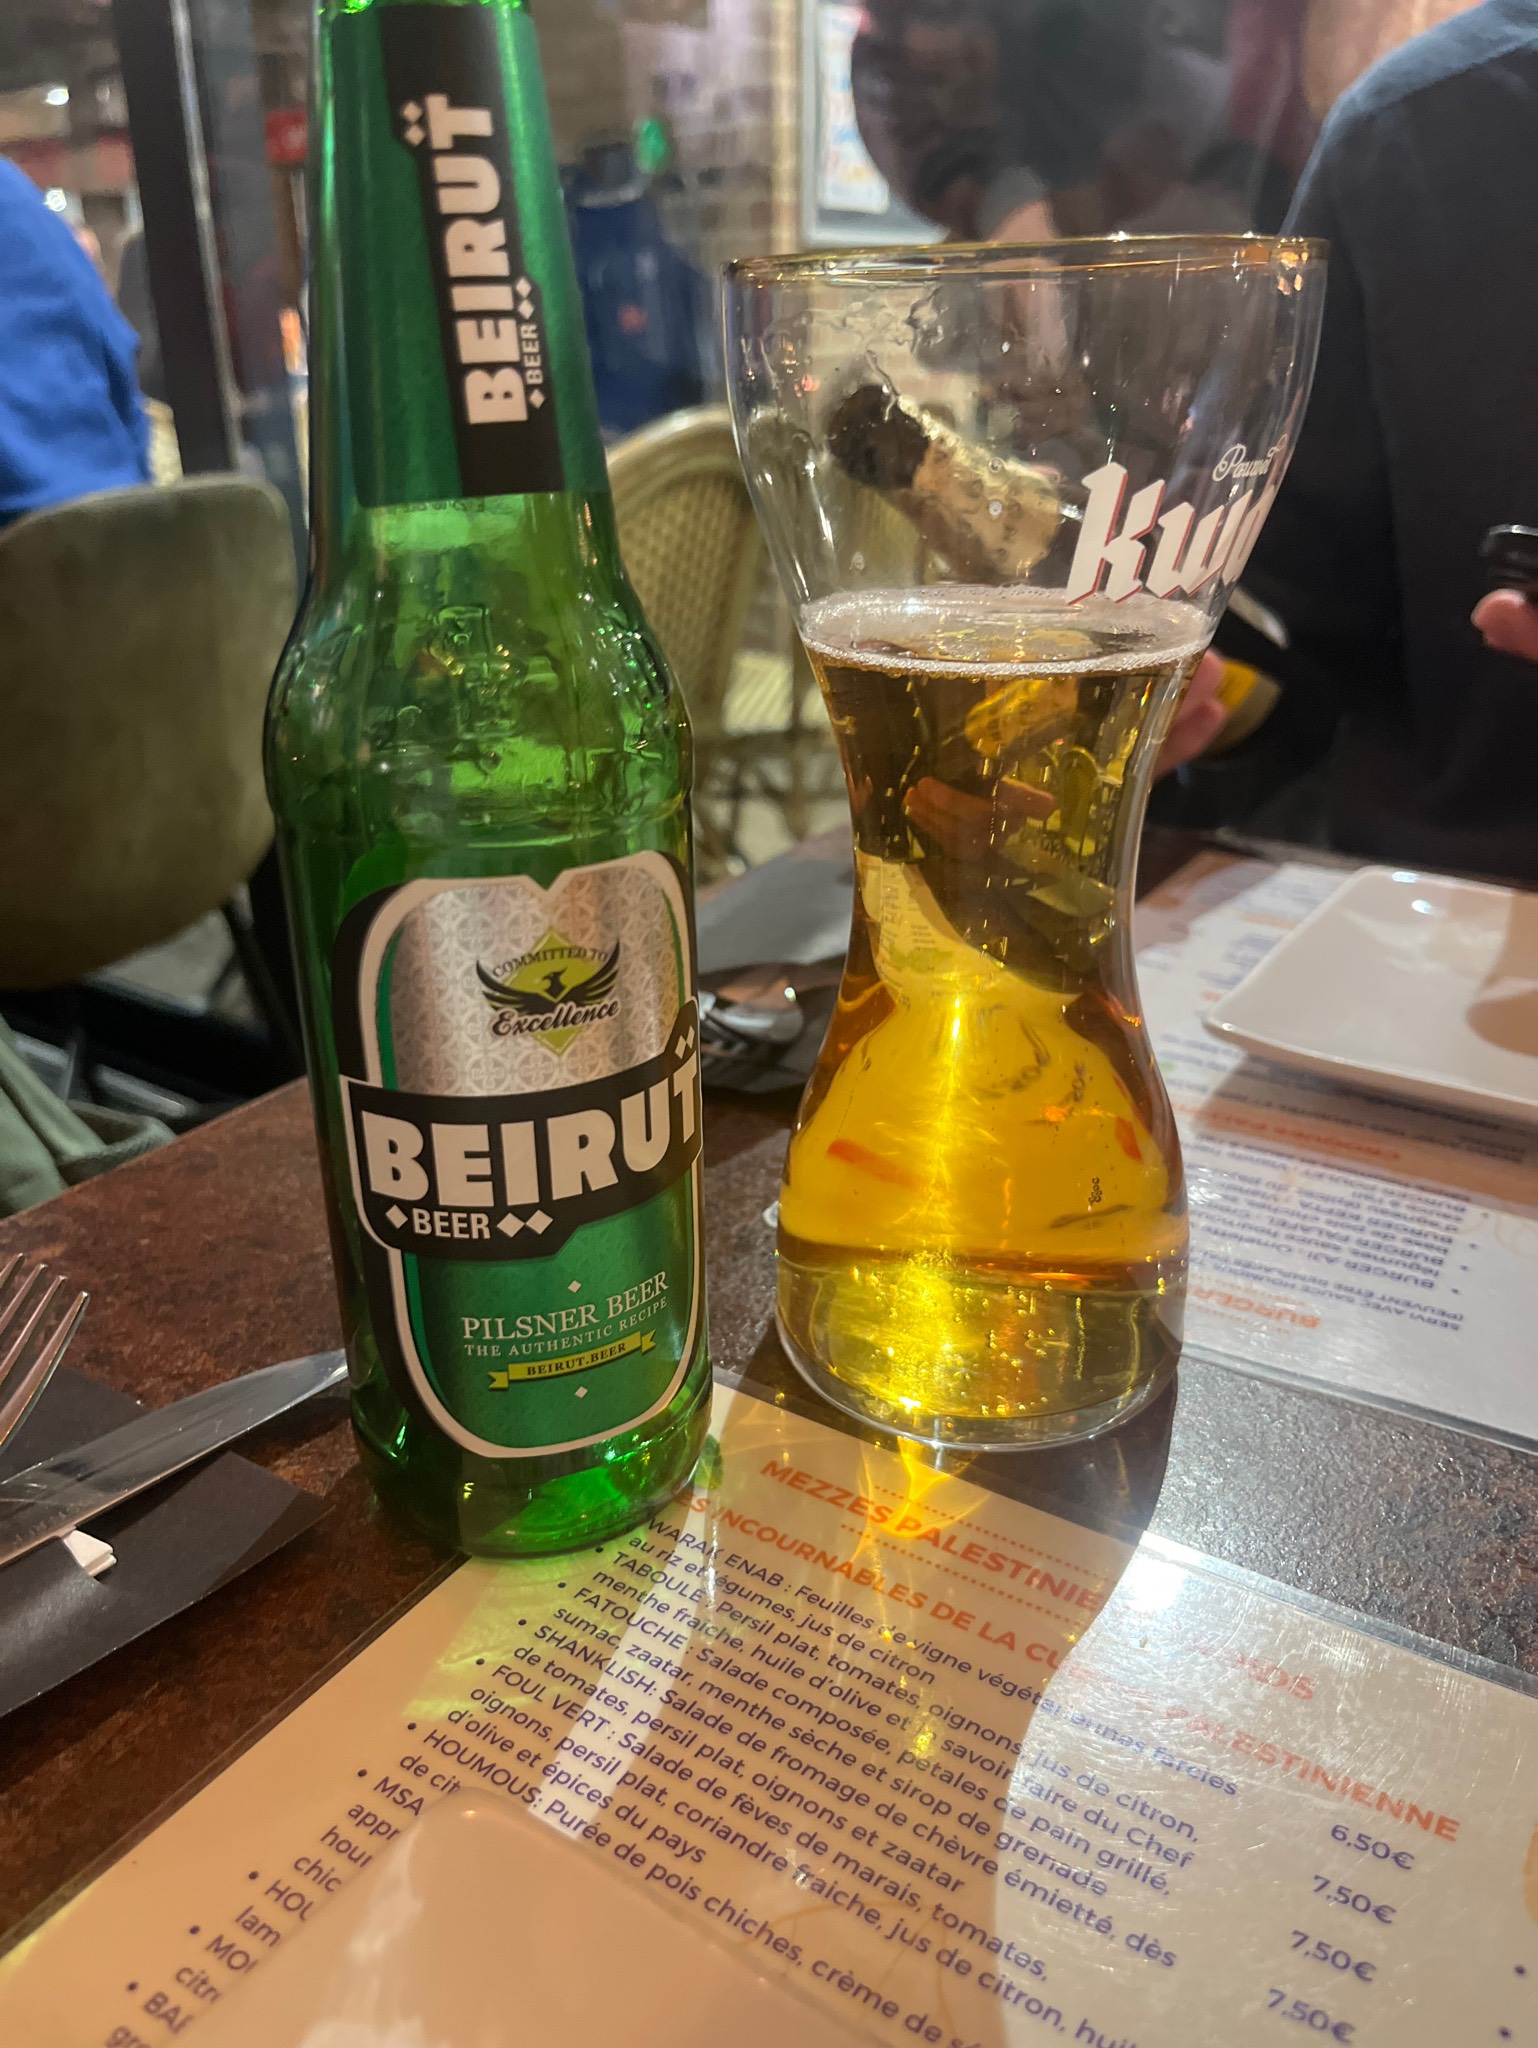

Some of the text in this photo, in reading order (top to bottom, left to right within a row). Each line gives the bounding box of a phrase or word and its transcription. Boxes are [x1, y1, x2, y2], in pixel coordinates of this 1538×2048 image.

[521, 324, 543, 386] BEER
[492, 946, 609, 979] COMMITTED TO
[492, 999, 619, 1037] Excellence
[413, 1207, 491, 1240] BEER
[461, 1271, 669, 1341] PILSNER BEER
[464, 1296, 668, 1357] THE AUTHENTIC RECIPE
[526, 1342, 627, 1377] BEIRUT.BEER
[760, 1460, 898, 1525] MEZZES
[895, 1514, 1104, 1612] PALESTINIE
[628, 1535, 651, 1549] au
[656, 1547, 683, 1566] riz
[685, 1561, 706, 1578] et
[799, 1614, 834, 1638] jus
[837, 1630, 866, 1652] de
[869, 1645, 936, 1685] citron
[649, 1518, 725, 1560] WARAK
[724, 1553, 784, 1588] ENAB
[794, 1585, 875, 1630] Feuilles
[913, 1638, 972, 1675] vigne
[1151, 1746, 1238, 1796] farcies
[930, 1601, 975, 1632] DE
[976, 1621, 1017, 1652] LA
[400, 1755, 430, 1777] de
[513, 1645, 541, 1667] de
[546, 1660, 629, 1717] tomates,
[631, 1708, 699, 1749] persil
[694, 1742, 747, 1779] plat,
[752, 1771, 848, 1830] oignons
[851, 1825, 879, 1848] et
[881, 1841, 965, 1893] zaatar
[553, 1607, 621, 1651] sumac,
[625, 1642, 695, 1688] zaatar,
[698, 1679, 787, 1731] menthe
[788, 1723, 857, 1768] sèche
[861, 1761, 888, 1783] et
[889, 1775, 952, 1818] sirop
[957, 1810, 992, 1836] de
[994, 1831, 1109, 1897] grenade
[573, 1587, 689, 1650] FATOUCHE
[695, 1647, 769, 1692] Salade
[771, 1687, 891, 1756] composée,
[993, 1796, 1027, 1820] de
[1029, 1815, 1091, 1855] pain
[1097, 1848, 1171, 1897] grillé,
[1331, 1824, 1415, 1870] 6,50€
[592, 1571, 671, 1614] menthe
[750, 1644, 805, 1680] huile
[885, 1711, 912, 1732] et
[1083, 1805, 1119, 1836] du
[1126, 1826, 1196, 1868] Chef
[715, 1600, 776, 1639] Persil
[772, 1627, 821, 1661] plat,
[827, 1652, 921, 1709] tomates,
[1027, 1751, 1071, 1779] jus
[1076, 1773, 1110, 1797] de
[1115, 1792, 1200, 1843] citron,
[373, 1776, 426, 1817] MSA
[470, 1687, 553, 1742] oignons,
[554, 1735, 623, 1777] persil
[616, 1770, 667, 1807] plat,
[673, 1801, 789, 1872] coriandre
[884, 1918, 932, 1954] jus
[935, 1947, 973, 1976] de
[977, 1970, 1066, 2033] citron,
[492, 1664, 547, 1703] FOUL
[550, 1694, 611, 1734] VERT
[617, 1732, 693, 1781] Salade
[696, 1775, 728, 1800] de
[730, 1790, 793, 1836] fèves
[796, 1831, 829, 1856] de
[832, 1851, 923, 1913] marais,
[931, 1902, 1048, 1982] tomates,
[516, 1748, 544, 1769] et
[541, 1760, 615, 1810] épices
[614, 1801, 649, 1829] du
[646, 1822, 707, 1864] pays
[533, 1624, 1378, 1983] SHANKLISH: Salade de fromage de chèvre émietté, dès 7,50€
[423, 1728, 943, 2043] HOUMOUS: Purée de pois chiches, crème de
[205, 1934, 259, 1974] MO
